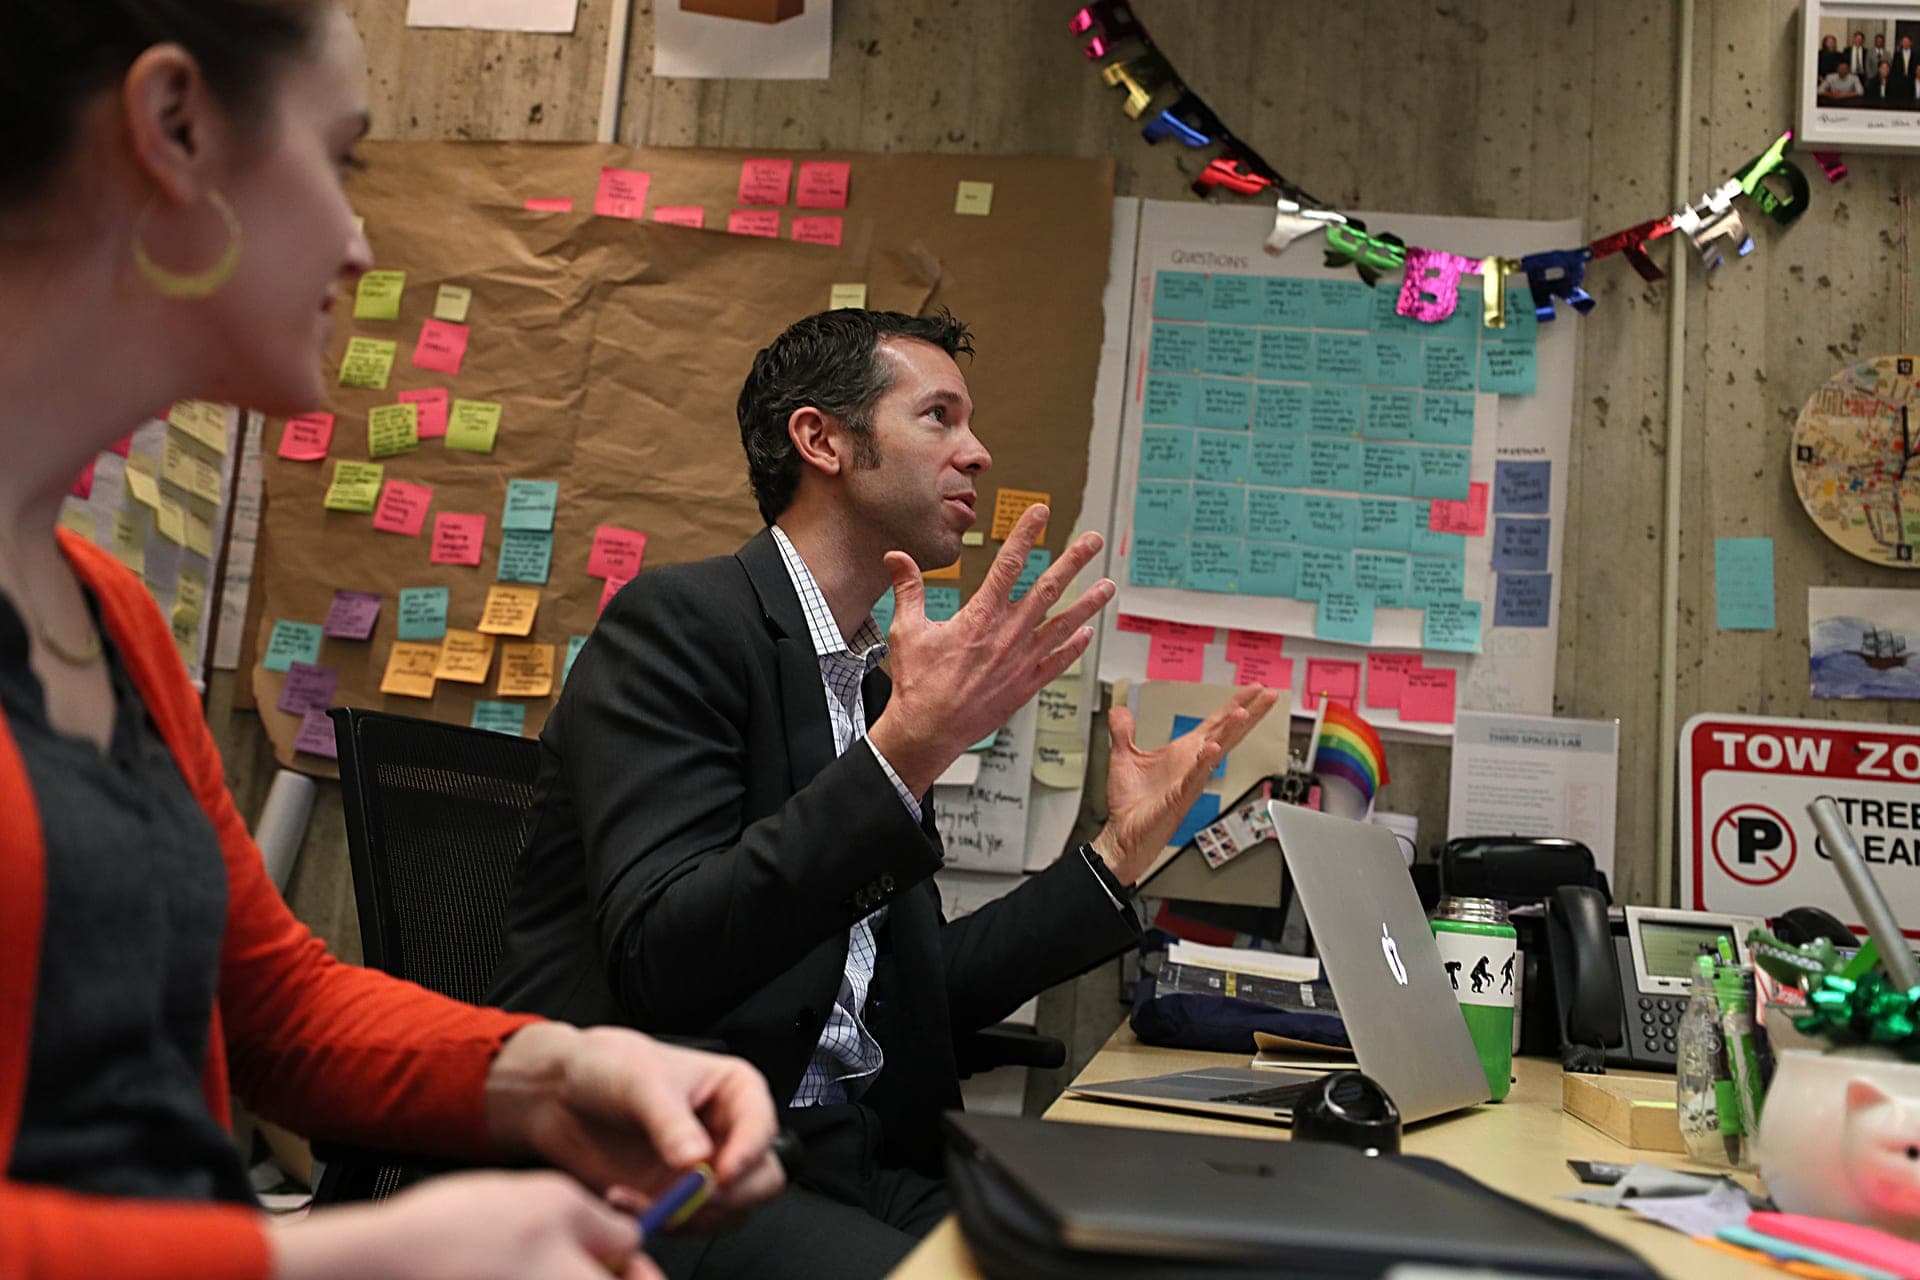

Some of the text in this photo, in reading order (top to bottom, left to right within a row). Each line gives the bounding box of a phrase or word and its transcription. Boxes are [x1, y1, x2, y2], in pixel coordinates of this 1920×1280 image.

[1171, 250, 1248, 268] QUESTIONS
[1489, 733, 1582, 748] THIRD SPACES LAB
[1712, 732, 1920, 779] TOW ZO
[1815, 795, 1920, 831] TRE
[1738, 816, 1783, 864] P
